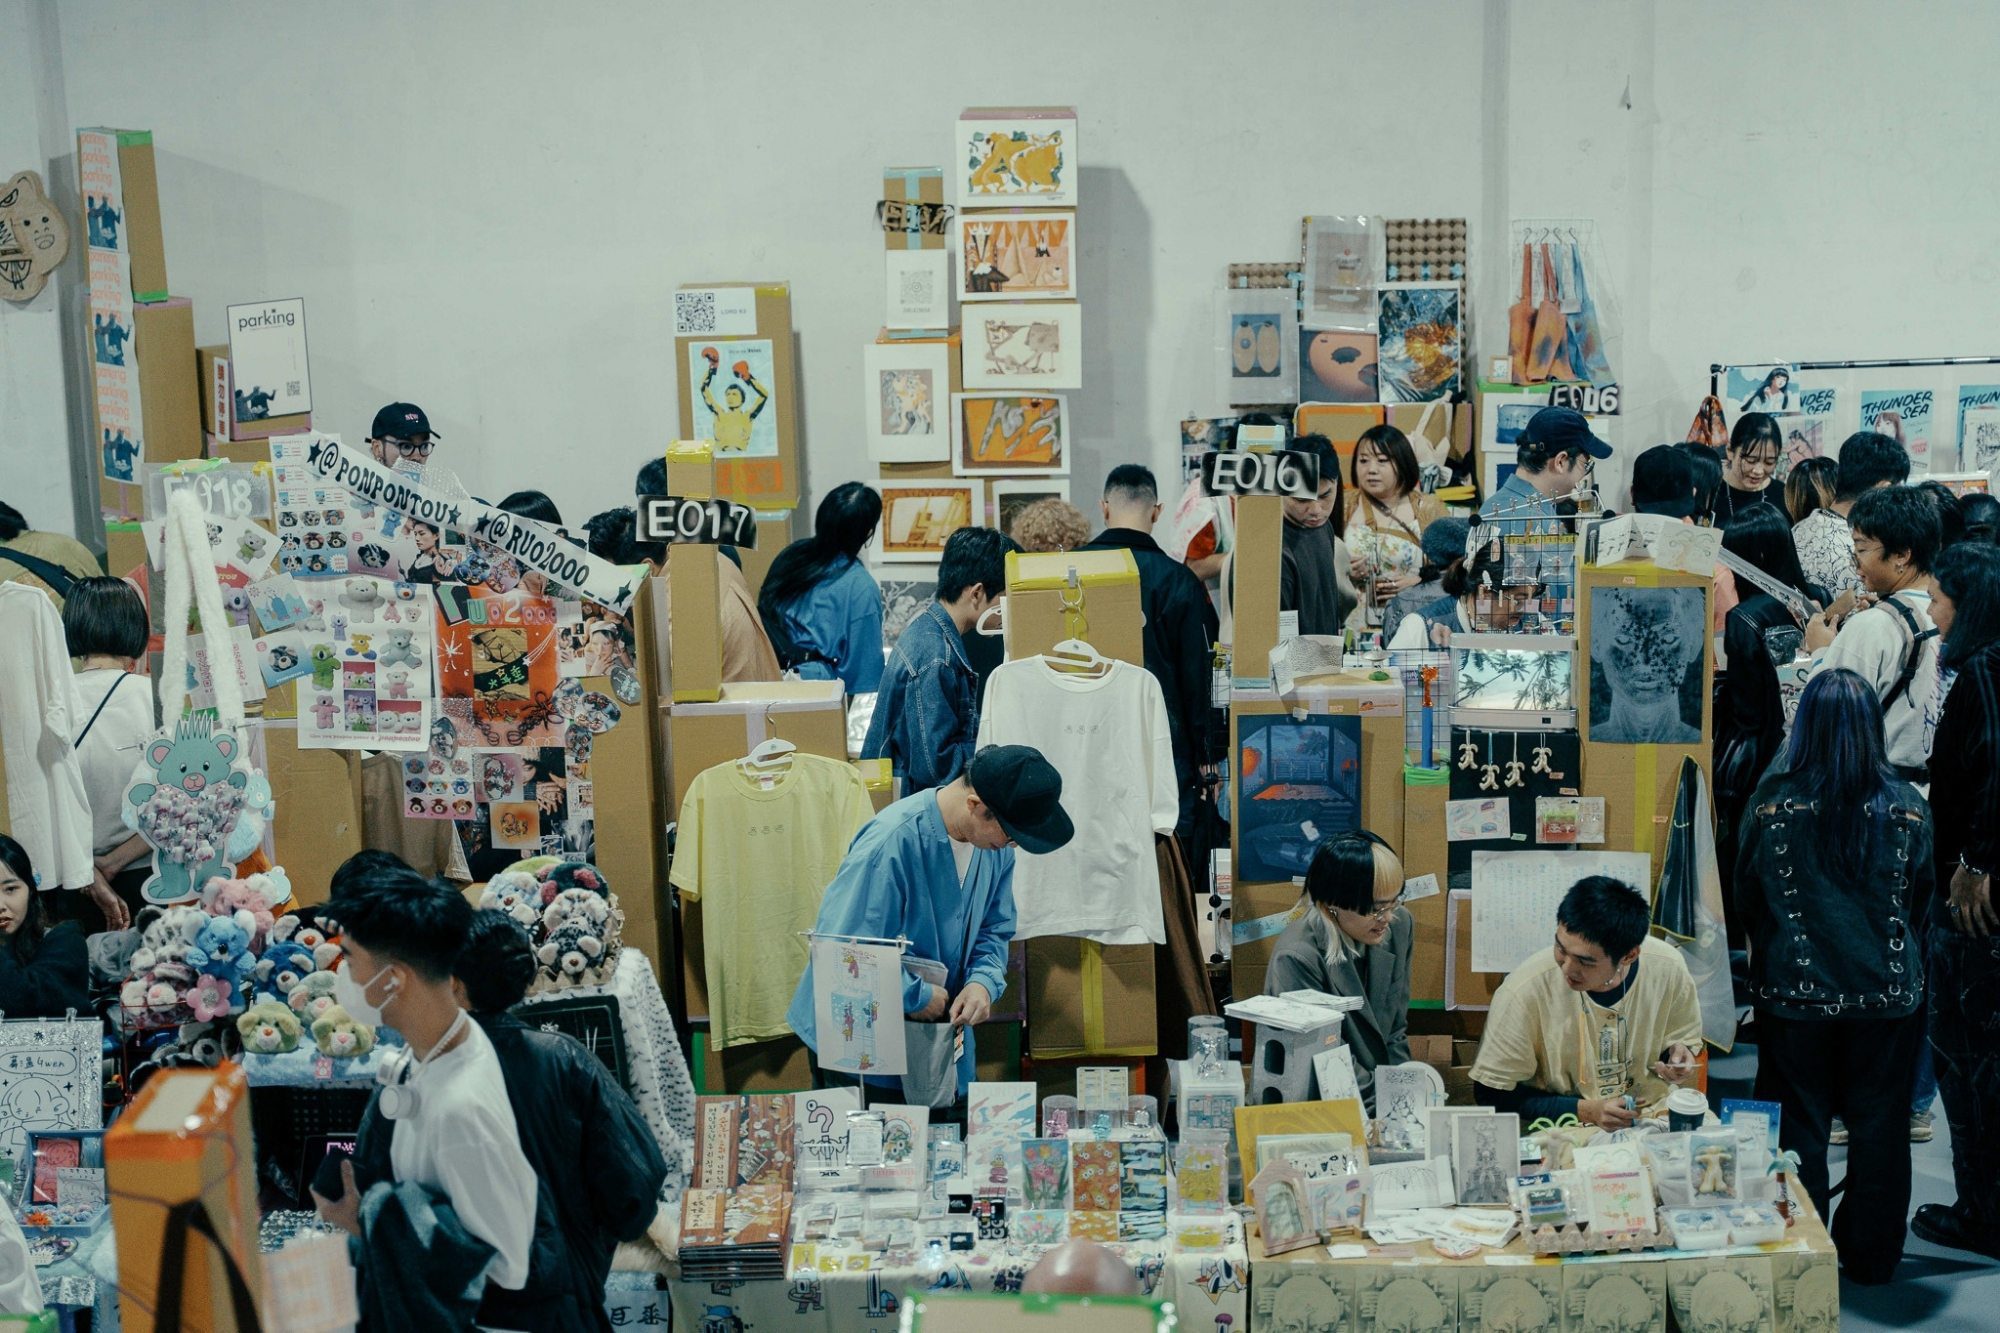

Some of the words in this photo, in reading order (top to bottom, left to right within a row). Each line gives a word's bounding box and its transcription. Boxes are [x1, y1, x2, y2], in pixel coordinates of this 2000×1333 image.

[238, 307, 295, 332] parking
[1862, 390, 1934, 416] THUNDER
[1901, 403, 1930, 420] SEA
[1211, 452, 1301, 492] E016
[648, 500, 749, 542] E017
